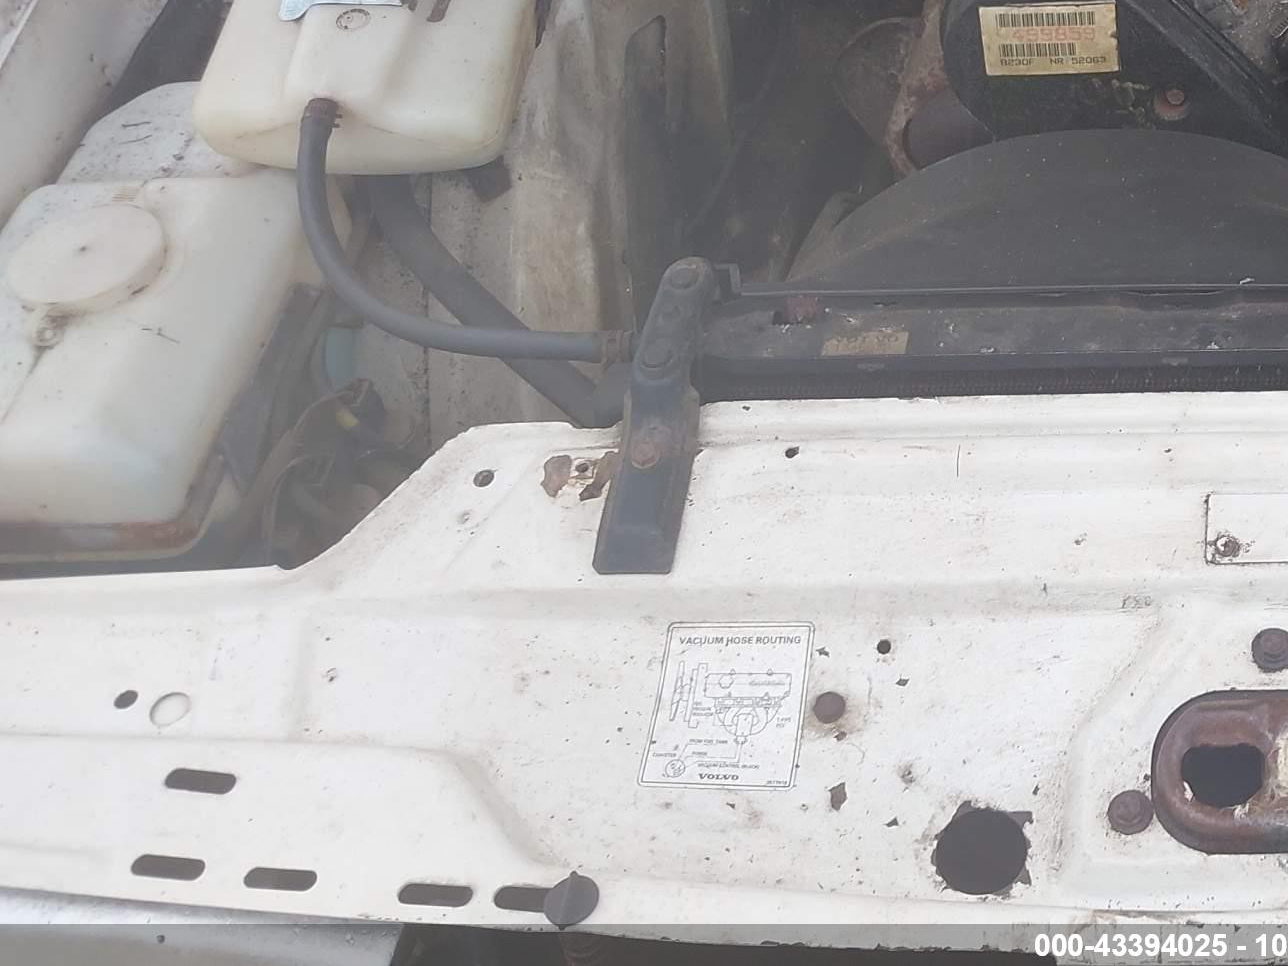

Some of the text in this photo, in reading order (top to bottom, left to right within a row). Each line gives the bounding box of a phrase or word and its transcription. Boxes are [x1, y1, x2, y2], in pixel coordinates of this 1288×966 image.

[678, 636, 801, 644] VACUUM HOSE ROUTING
[697, 772, 739, 781] VOLVO
